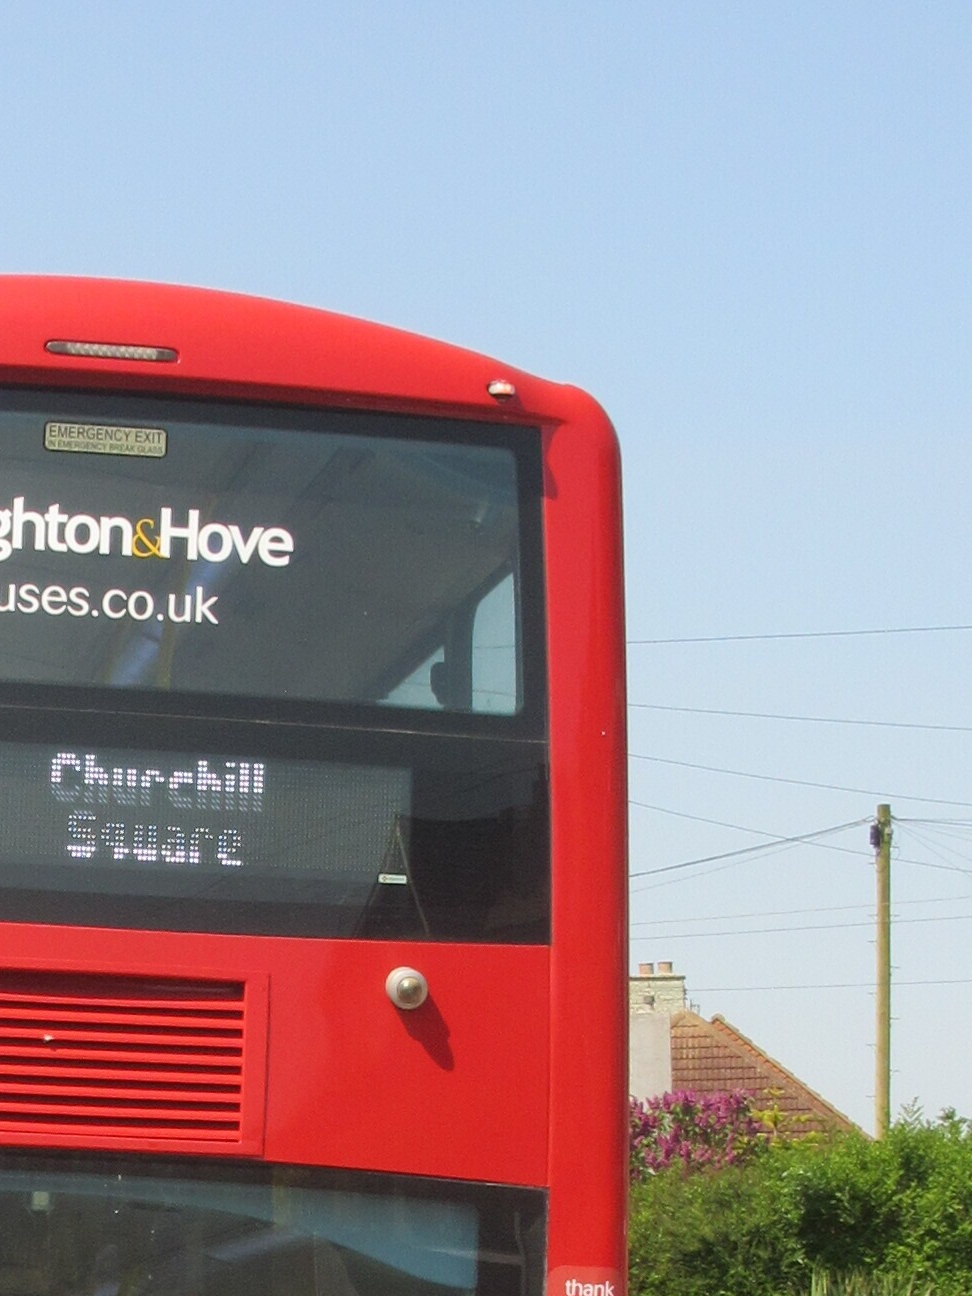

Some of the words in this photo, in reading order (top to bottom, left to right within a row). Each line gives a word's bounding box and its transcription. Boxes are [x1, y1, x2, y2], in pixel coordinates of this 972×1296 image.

[48, 425, 132, 442] EMERGENCY
[134, 431, 163, 444] EXIT
[58, 441, 108, 450] EMERGENCY
[109, 443, 135, 452] BREAK
[50, 752, 265, 812] Churchill
[65, 810, 244, 867] Square
